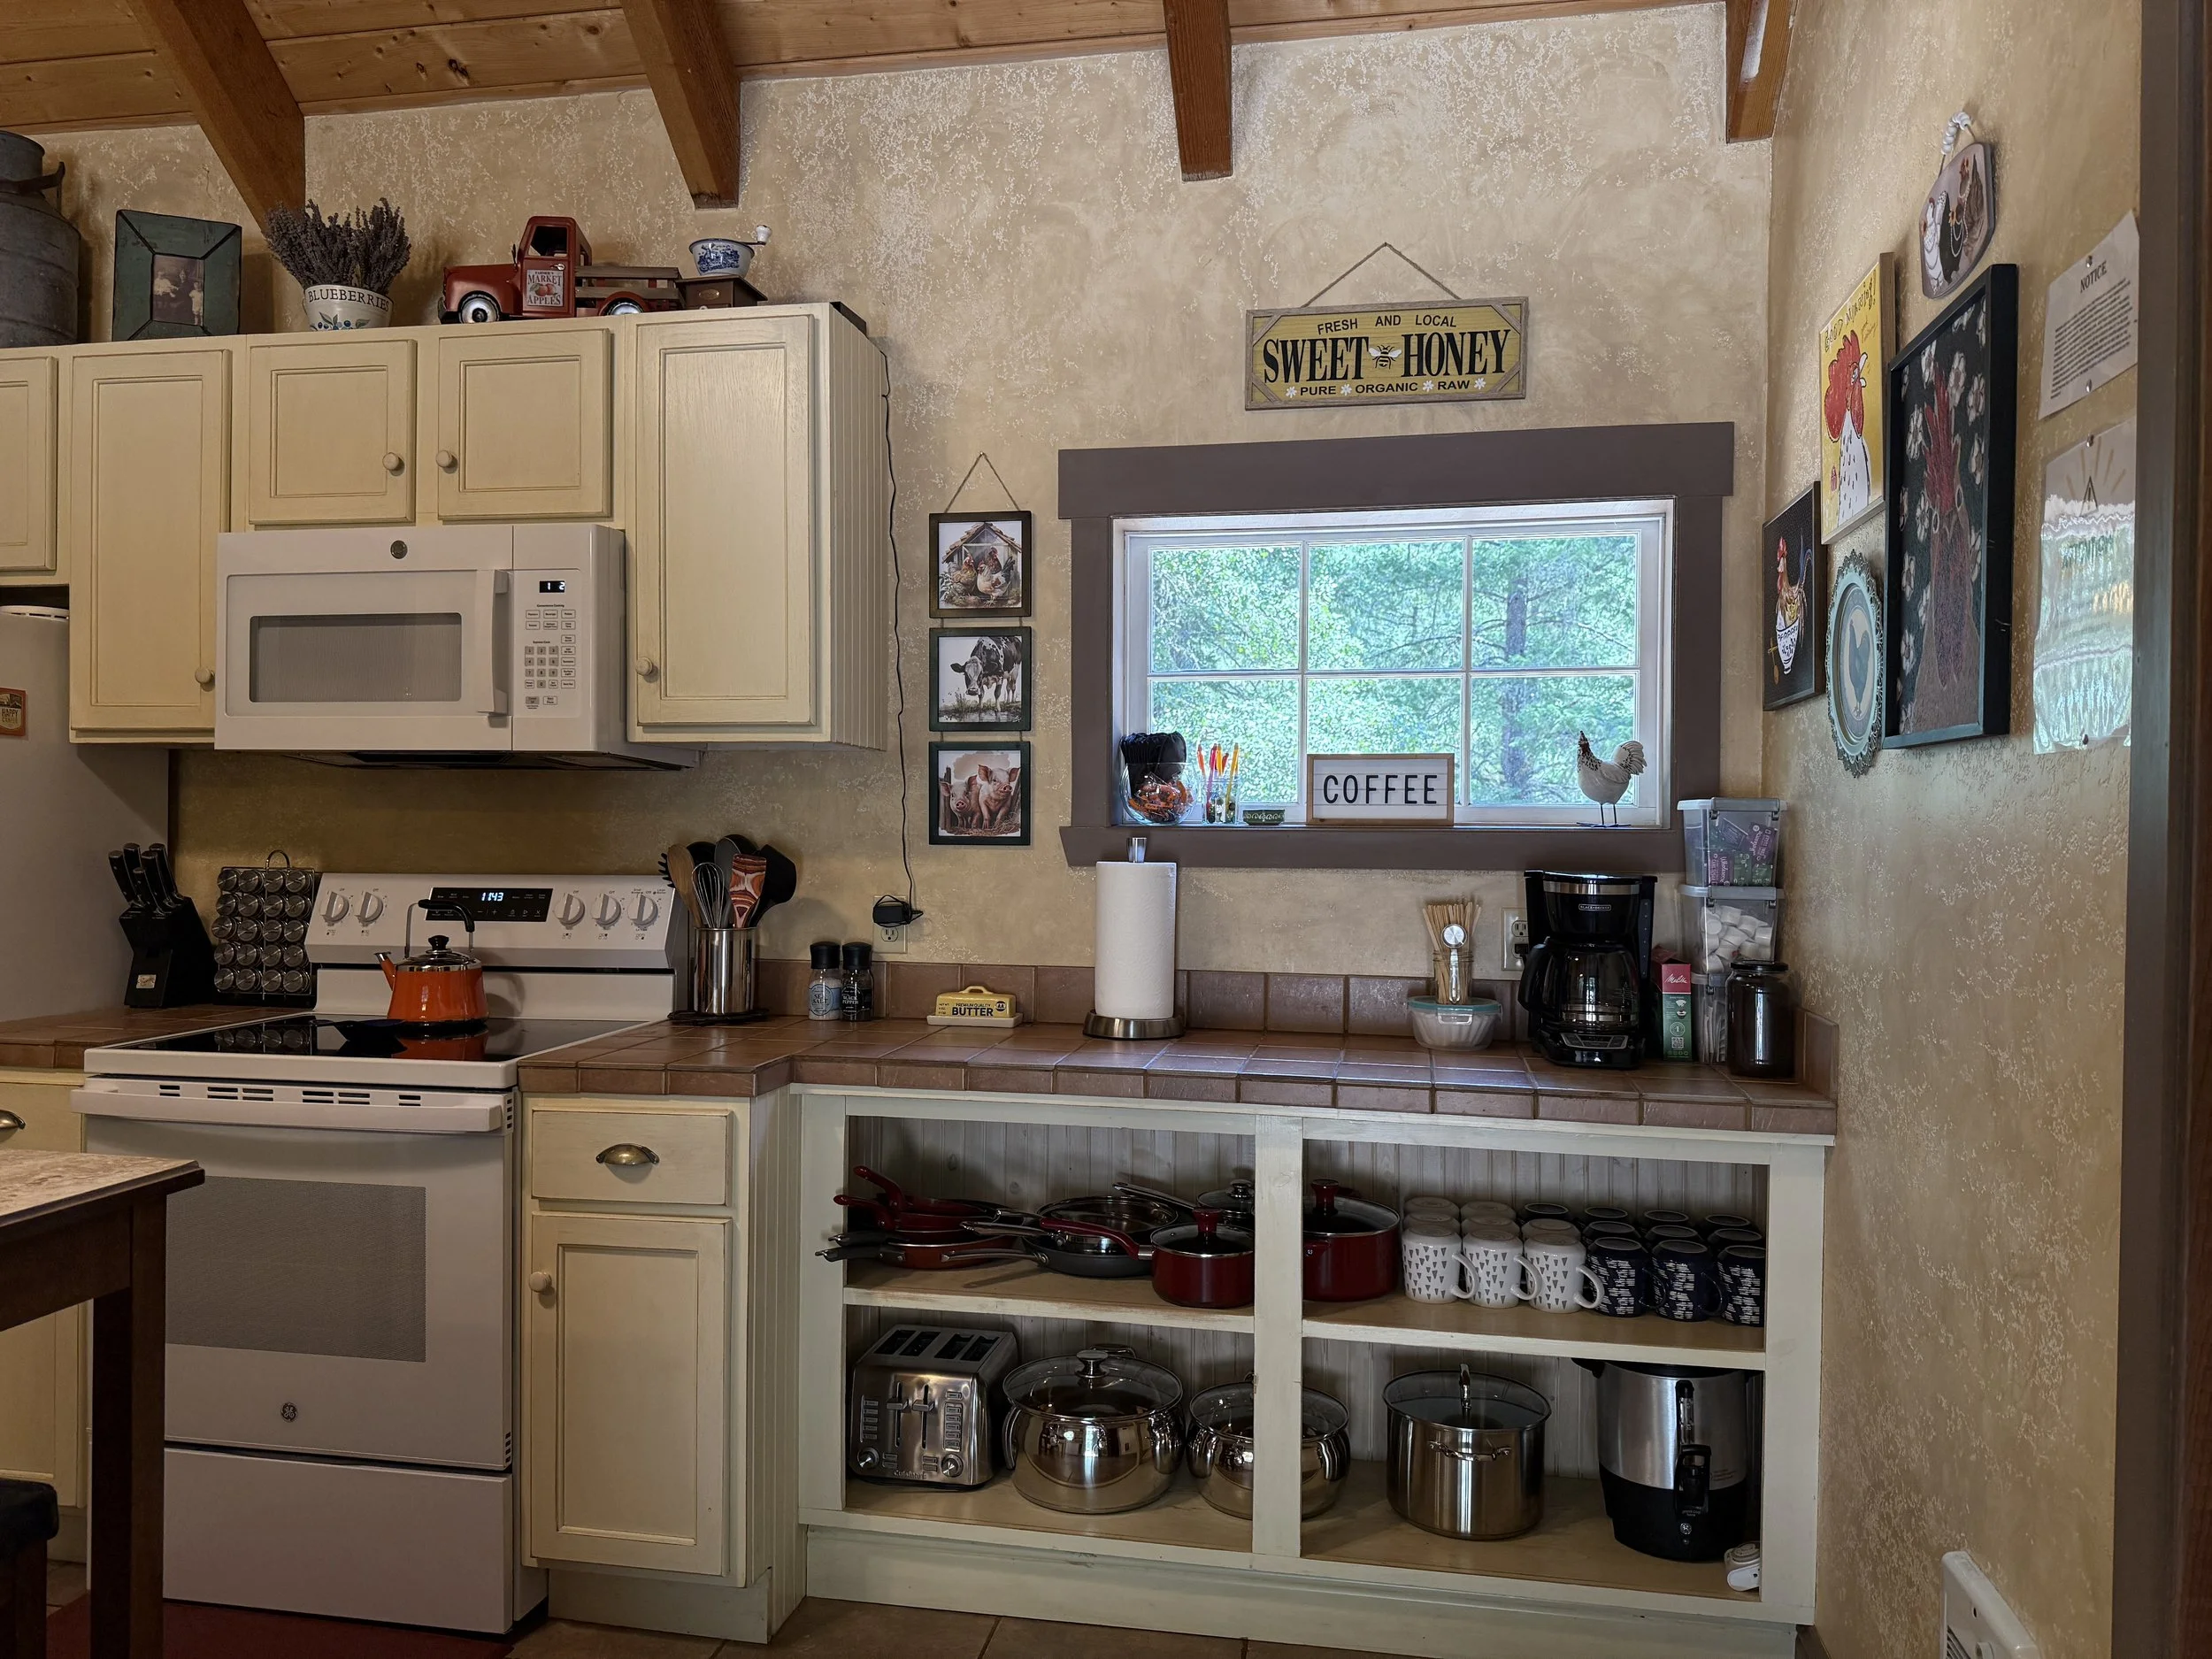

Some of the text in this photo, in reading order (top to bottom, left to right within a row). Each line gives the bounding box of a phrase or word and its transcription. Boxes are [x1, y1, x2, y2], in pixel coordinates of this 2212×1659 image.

[527, 274, 562, 287] MARKET
[2080, 260, 2108, 294] NOTICE
[308, 288, 389, 311] BLUEBERRIES
[527, 295, 561, 305] APPLES
[1317, 314, 1457, 335] FRESH AND LOCAL
[1824, 319, 1843, 353] GOOD
[1263, 329, 1511, 384] SWEET HONEY
[1300, 380, 1471, 396] PURE ORGANIC RAW
[2, 708, 19, 718] HAPPY
[1323, 774, 1438, 804] COFFEE
[951, 1007, 994, 1017] BUTTER
